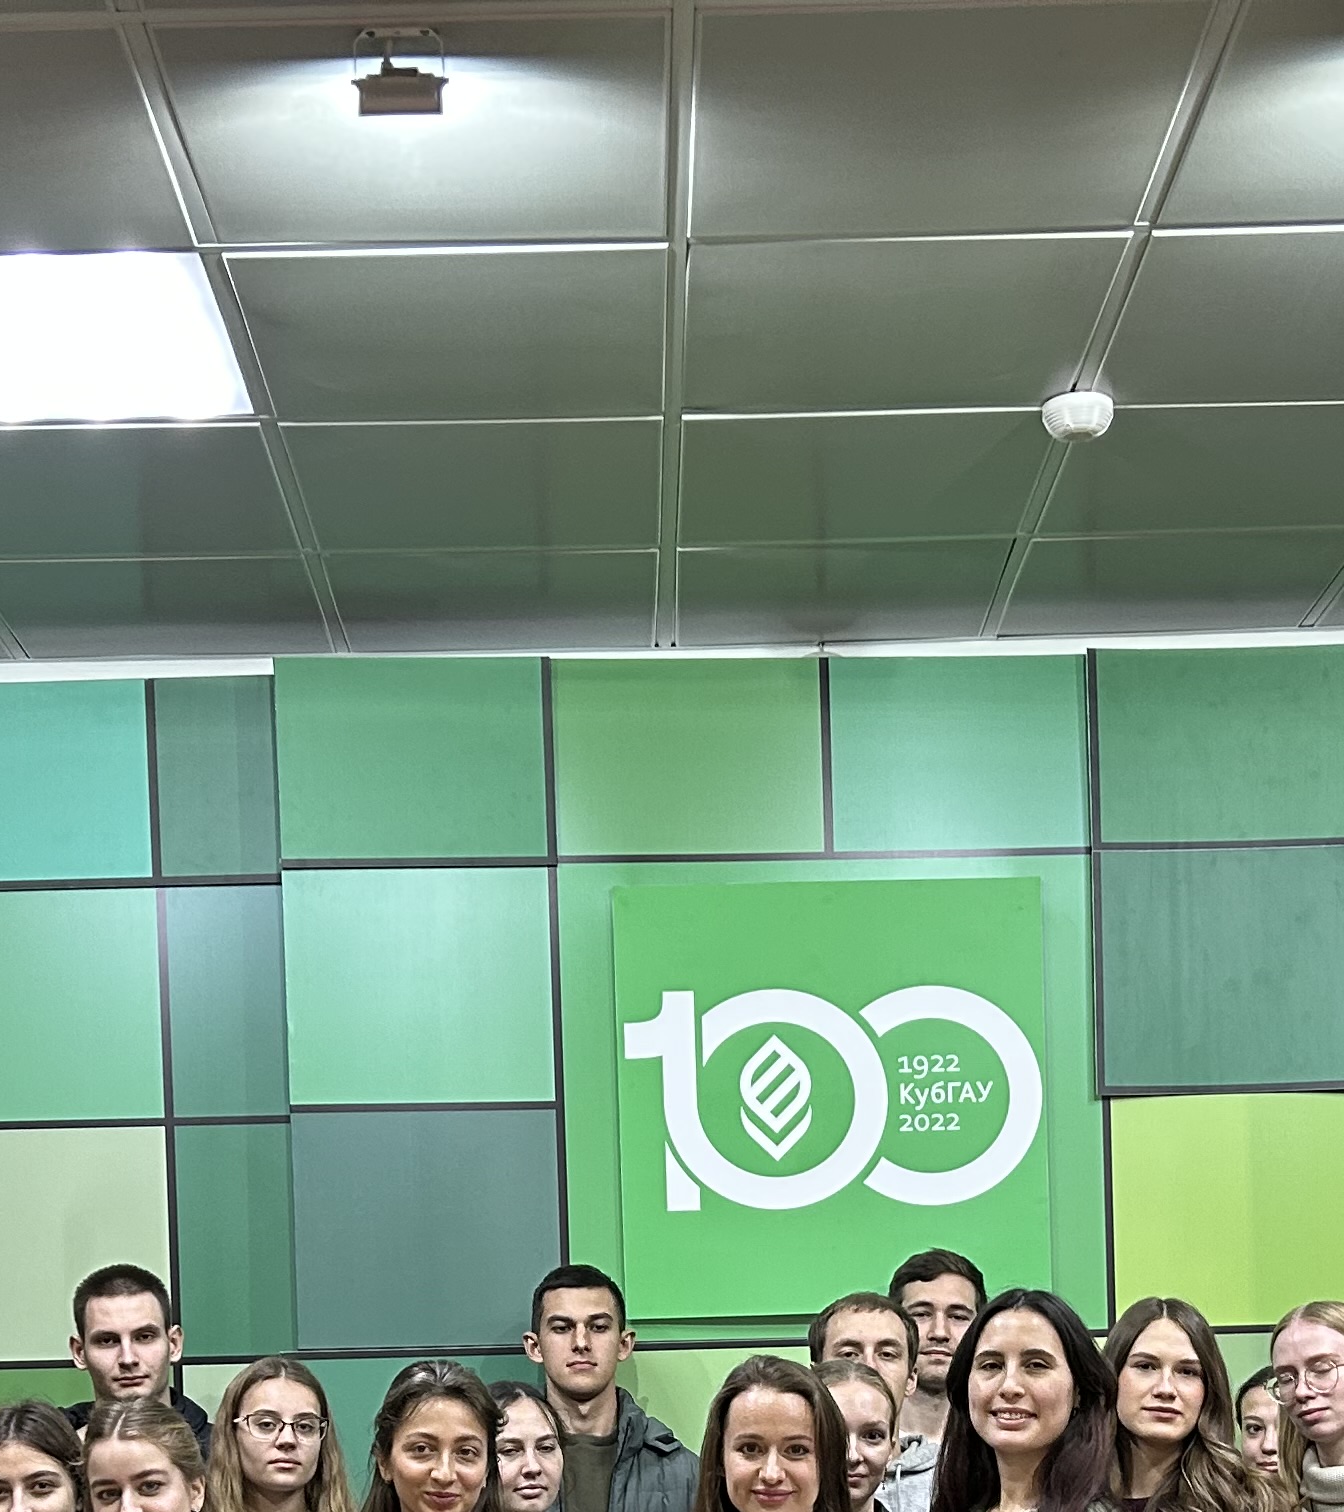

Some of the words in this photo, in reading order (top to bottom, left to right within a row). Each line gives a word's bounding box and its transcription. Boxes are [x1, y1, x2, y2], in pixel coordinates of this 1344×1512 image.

[897, 1054, 961, 1080] 1922
[623, 985, 1043, 1212] 100
[899, 1080, 994, 1111] КубГАУ
[899, 1112, 961, 1132] 2022
